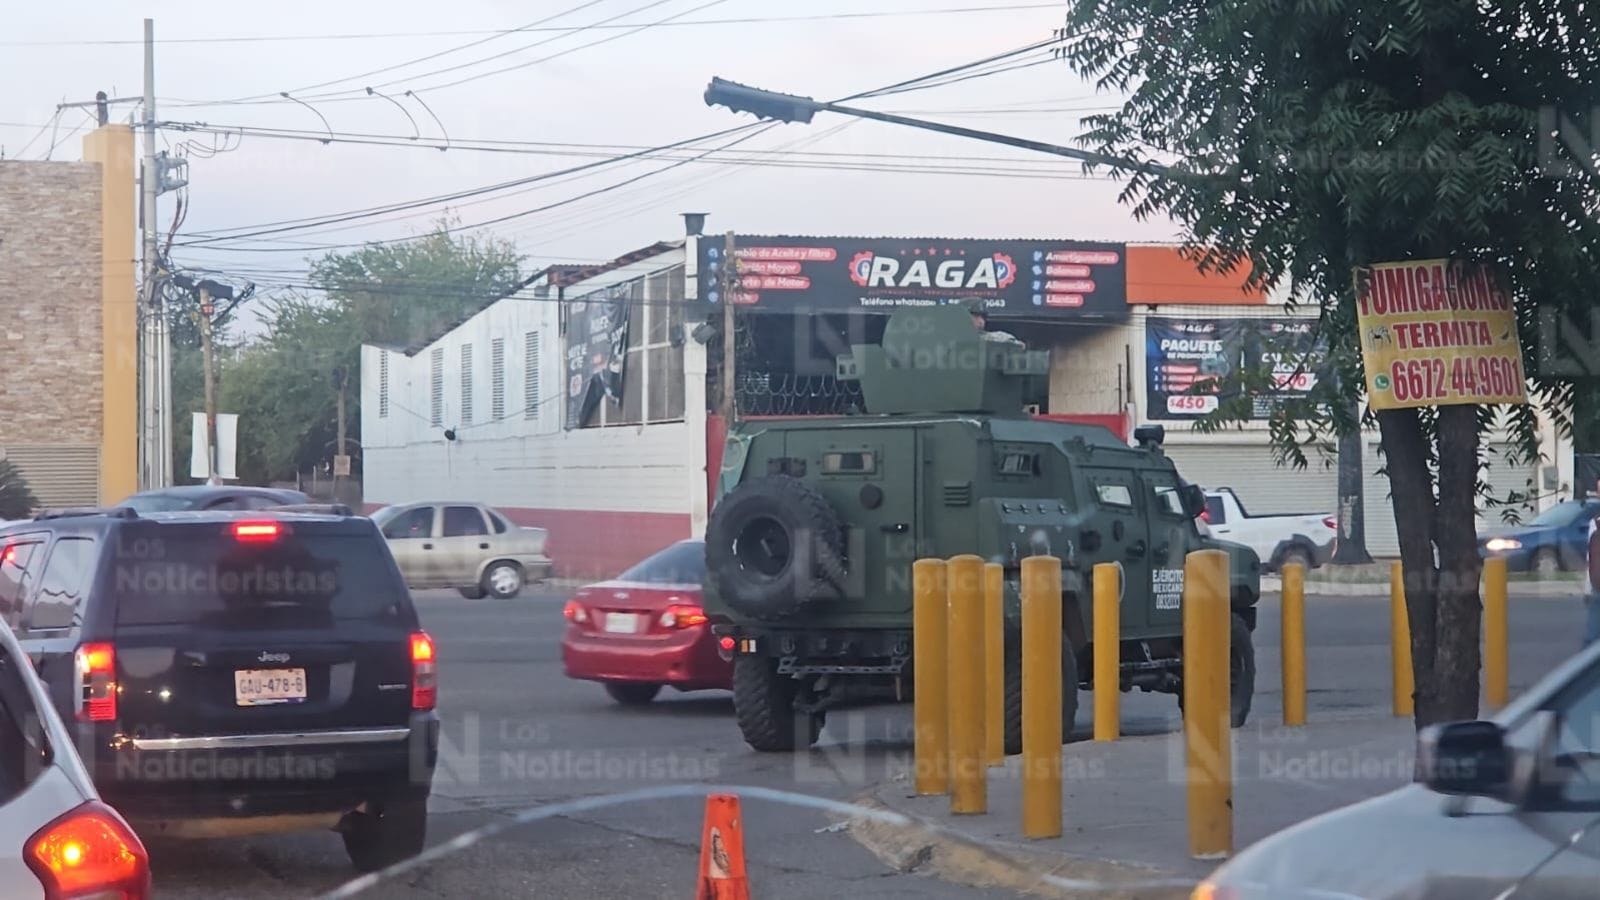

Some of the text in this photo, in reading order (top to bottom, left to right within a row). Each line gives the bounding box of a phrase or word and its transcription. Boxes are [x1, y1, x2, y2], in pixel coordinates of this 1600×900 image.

[723, 248, 757, 257] Cmbio
[869, 256, 997, 288] RAGA
[1393, 321, 1492, 349] TERMITA
[258, 651, 290, 663] Jeep
